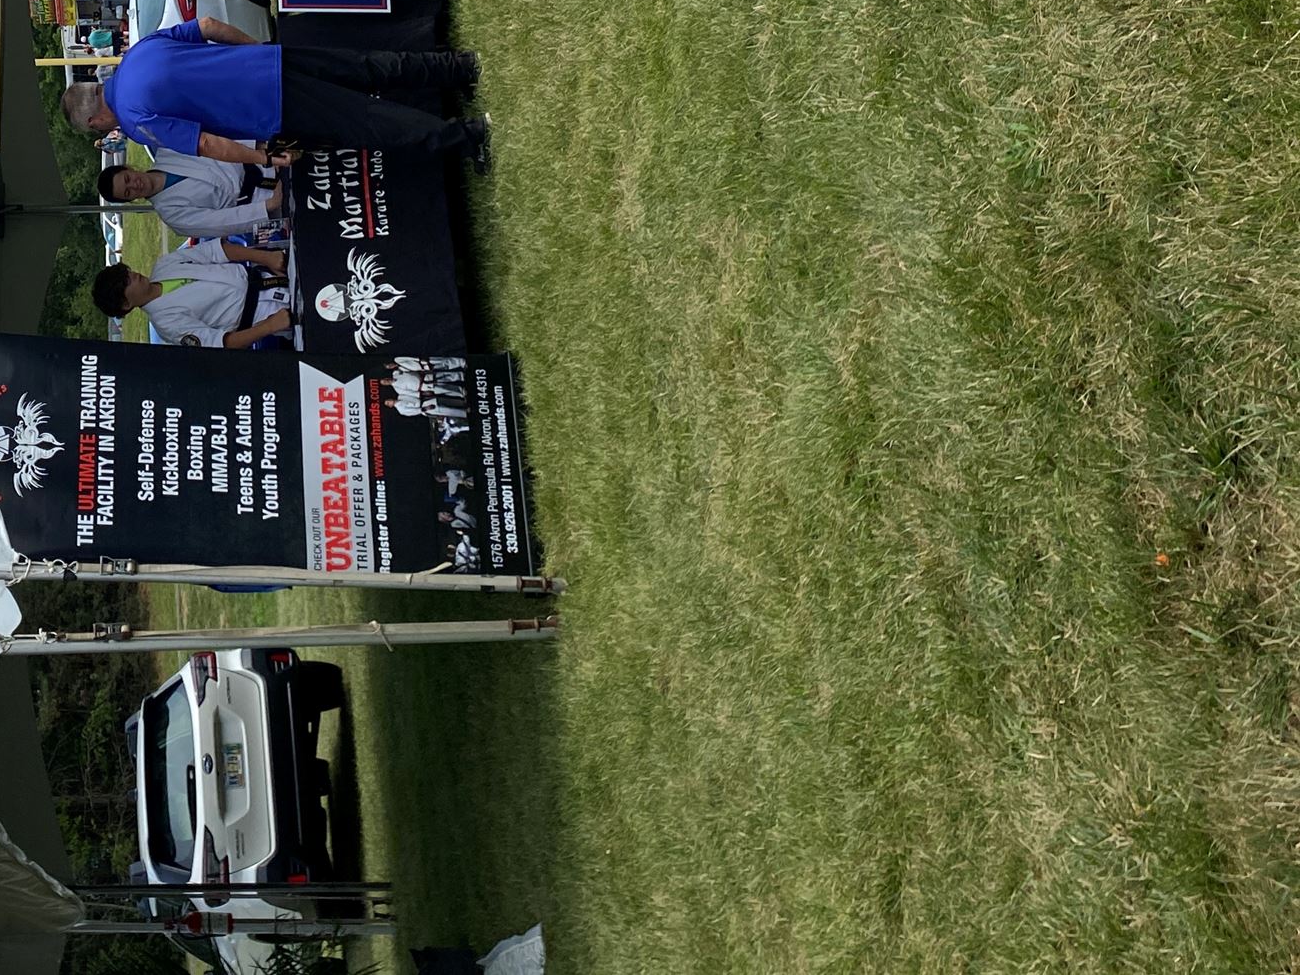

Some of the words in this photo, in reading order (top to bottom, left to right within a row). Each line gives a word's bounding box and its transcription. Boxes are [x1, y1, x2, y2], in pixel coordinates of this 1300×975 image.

[371, 150, 384, 179] Judo
[336, 149, 364, 239] Martial
[375, 190, 389, 236] Karate
[80, 355, 97, 429] TRAINING
[99, 375, 115, 431] AKRON
[476, 369, 488, 398] 44313
[235, 395, 252, 446] Adults
[369, 379, 384, 477] www.zahands.com
[479, 400, 490, 414] OH
[99, 436, 114, 451] IN
[138, 400, 154, 501] Self-Defense
[162, 408, 182, 496] Kickboxing
[187, 425, 206, 480] Boxing
[261, 392, 280, 469] Programs
[349, 401, 362, 467] PACKAGES
[480, 417, 492, 445] Akron,
[493, 386, 512, 475] www.zahands.com
[78, 434, 96, 510] ULTIMATE
[211, 415, 228, 493] MMA/BJJ
[236, 451, 252, 463] &
[483, 453, 494, 465] Rd
[97, 453, 114, 525] FACILITY
[237, 468, 253, 514] Teens
[261, 475, 279, 519] Youth
[318, 387, 352, 572] UNBEATABLE
[376, 480, 388, 521] Online:
[485, 467, 498, 512] Peninsula
[77, 515, 94, 546] THE
[312, 508, 320, 523] OUR
[353, 488, 365, 527] OFFER
[490, 514, 502, 542] Akron
[502, 485, 518, 553] 330.926.2001
[313, 526, 321, 541] OUT
[357, 533, 368, 570] TRIAL
[378, 524, 393, 573] Register
[492, 543, 504, 568] 1576
[313, 543, 322, 571] CHECK
